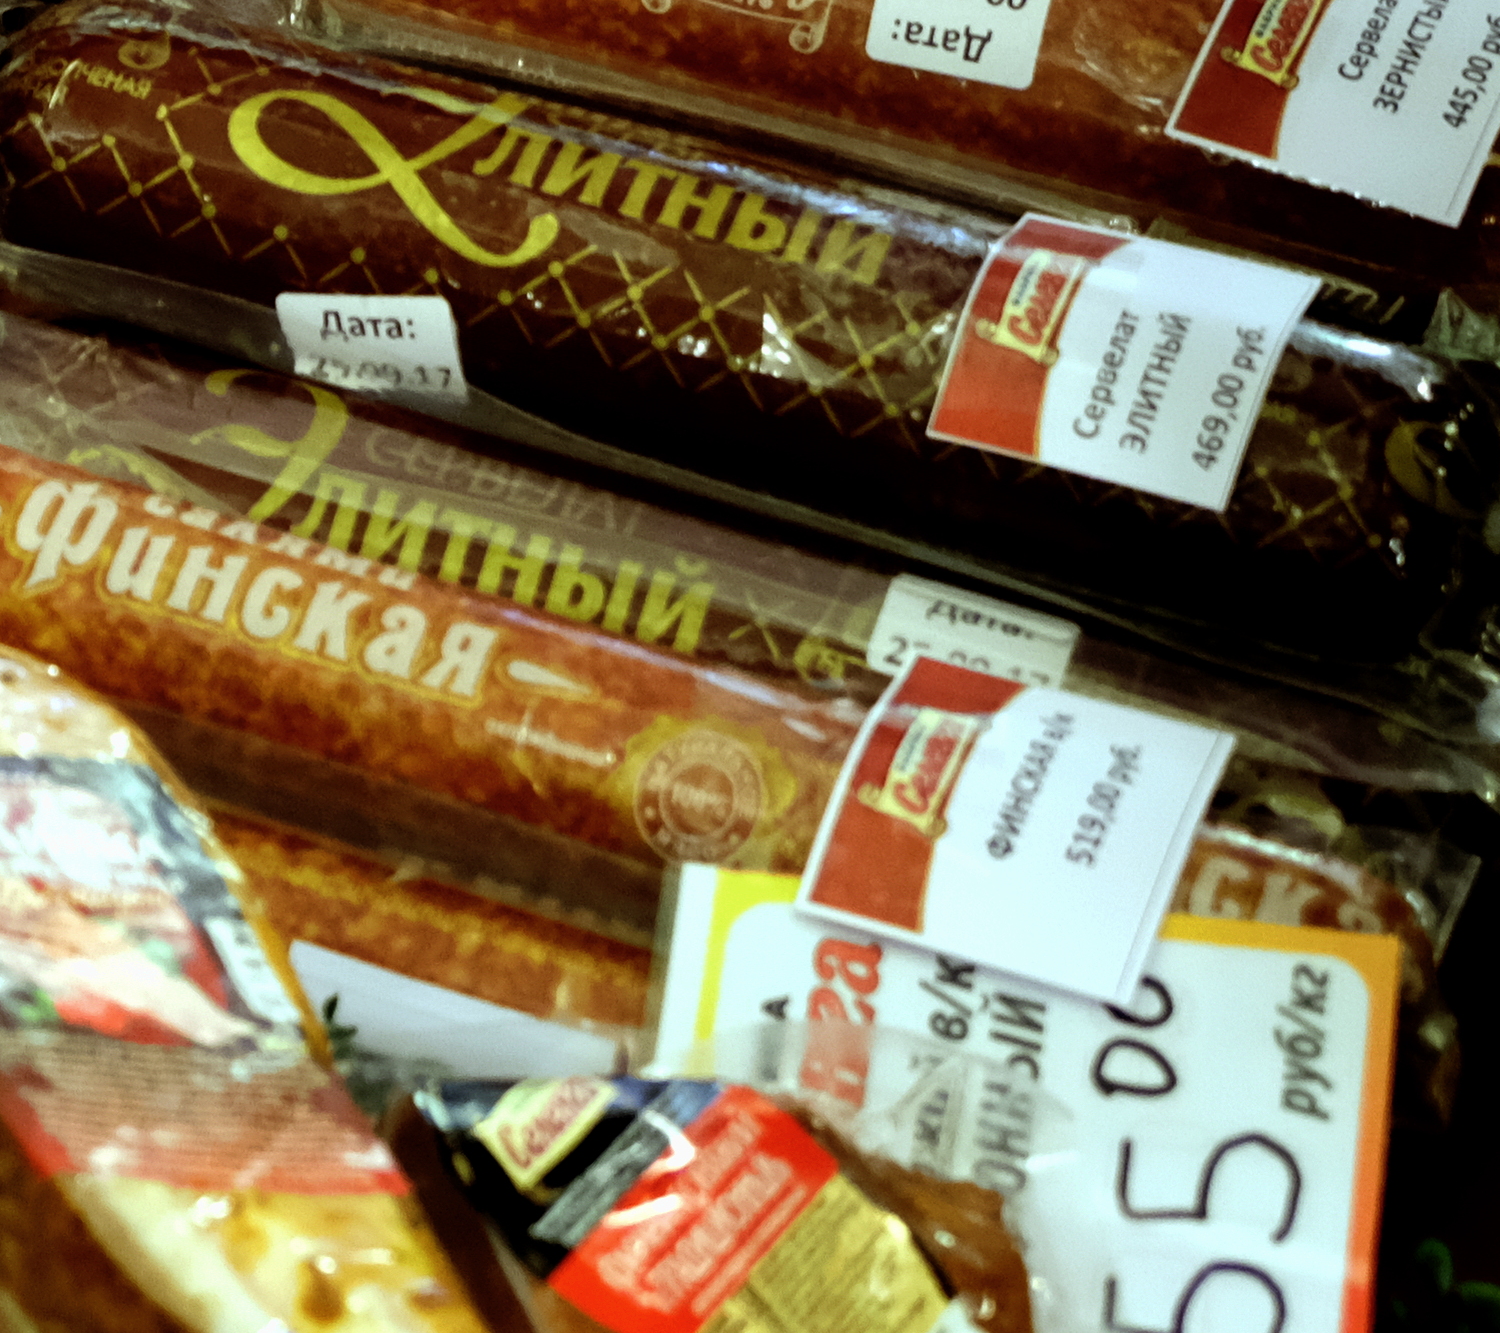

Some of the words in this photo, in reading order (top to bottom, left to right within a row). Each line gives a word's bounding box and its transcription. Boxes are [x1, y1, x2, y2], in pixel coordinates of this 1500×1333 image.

[886, 5, 993, 66] Дата:
[1441, 52, 1494, 131] 445,00
[319, 307, 418, 343] Дата:
[1072, 308, 1141, 441] Сервелат
[1117, 311, 1194, 456] ЭЛИТНЫЙ
[1191, 373, 1247, 473] 469,00
[10, 477, 500, 709] Финская
[979, 736, 1060, 863] ФИНСКАЯ
[1059, 778, 1128, 872] 519,00
[1263, 958, 1352, 1123] руб/кг
